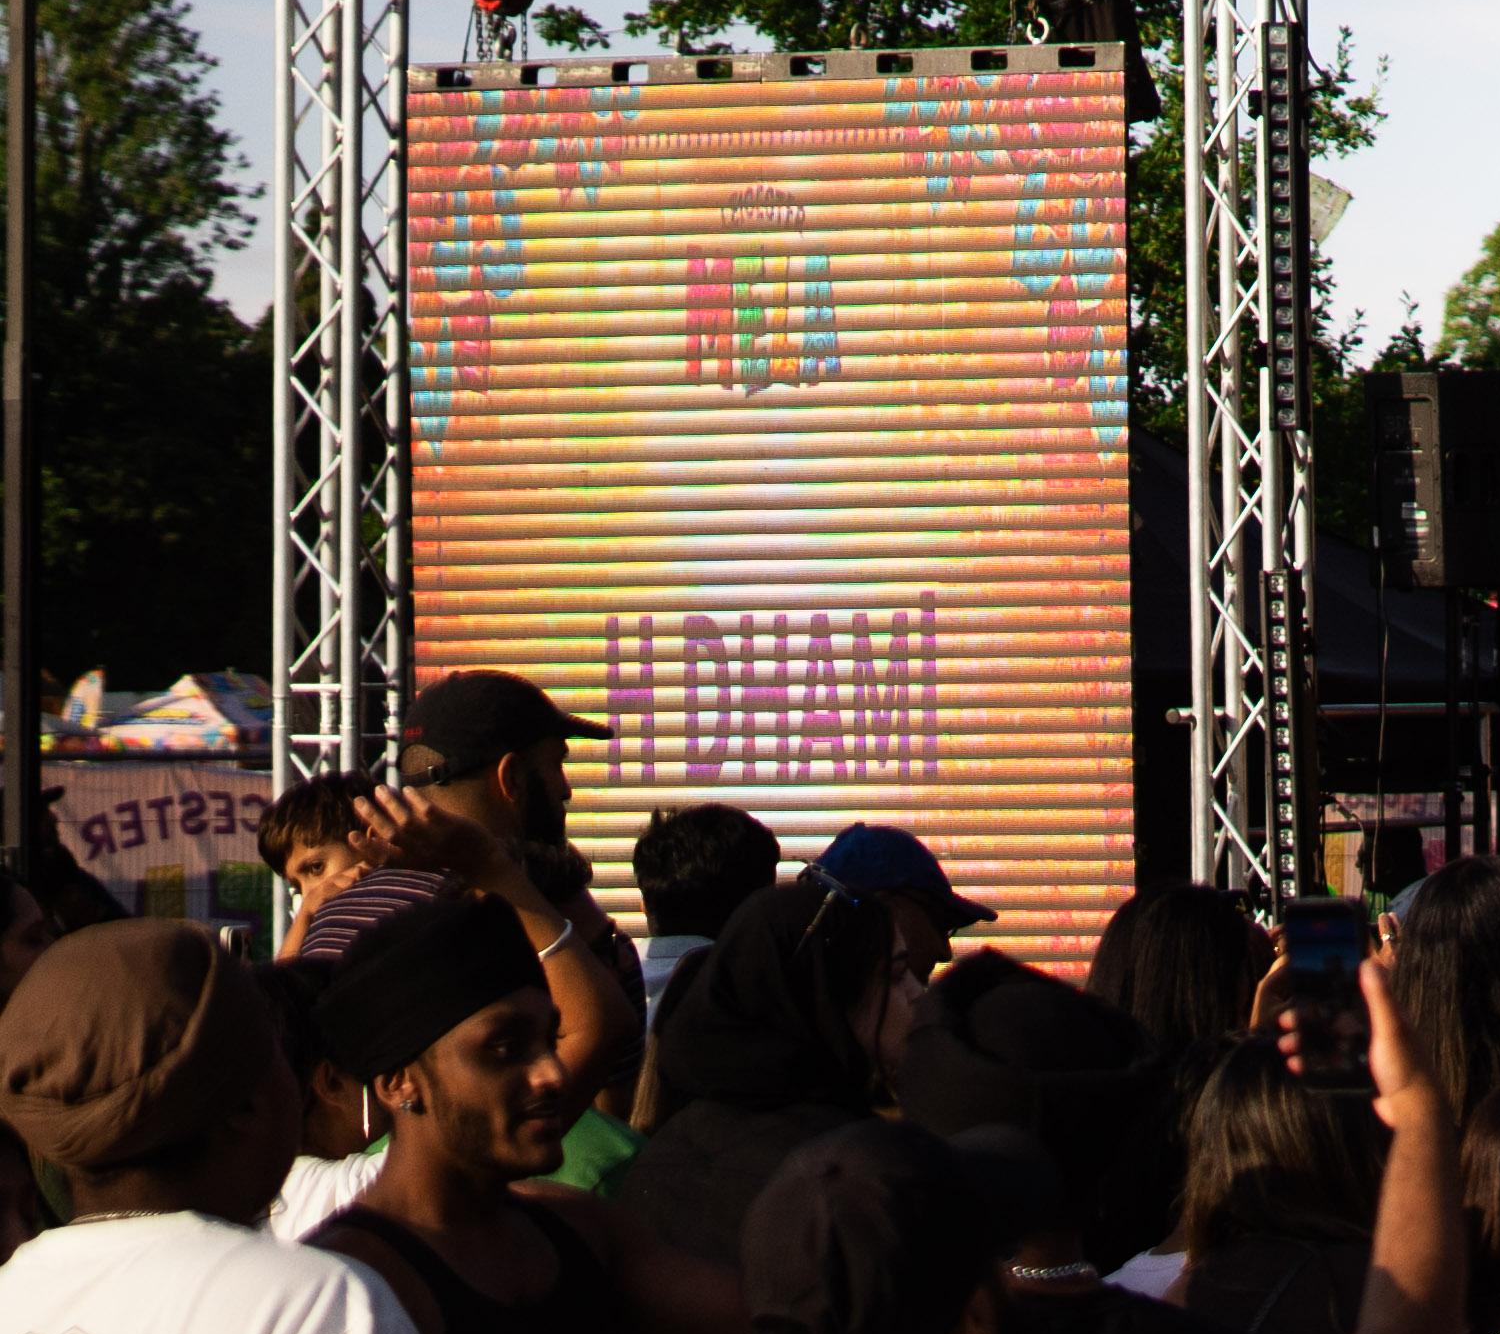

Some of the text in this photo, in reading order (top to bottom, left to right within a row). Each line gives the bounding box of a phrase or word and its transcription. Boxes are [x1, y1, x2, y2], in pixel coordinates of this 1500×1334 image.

[685, 243, 842, 397] MELA
[605, 591, 937, 784] H DHAMI
